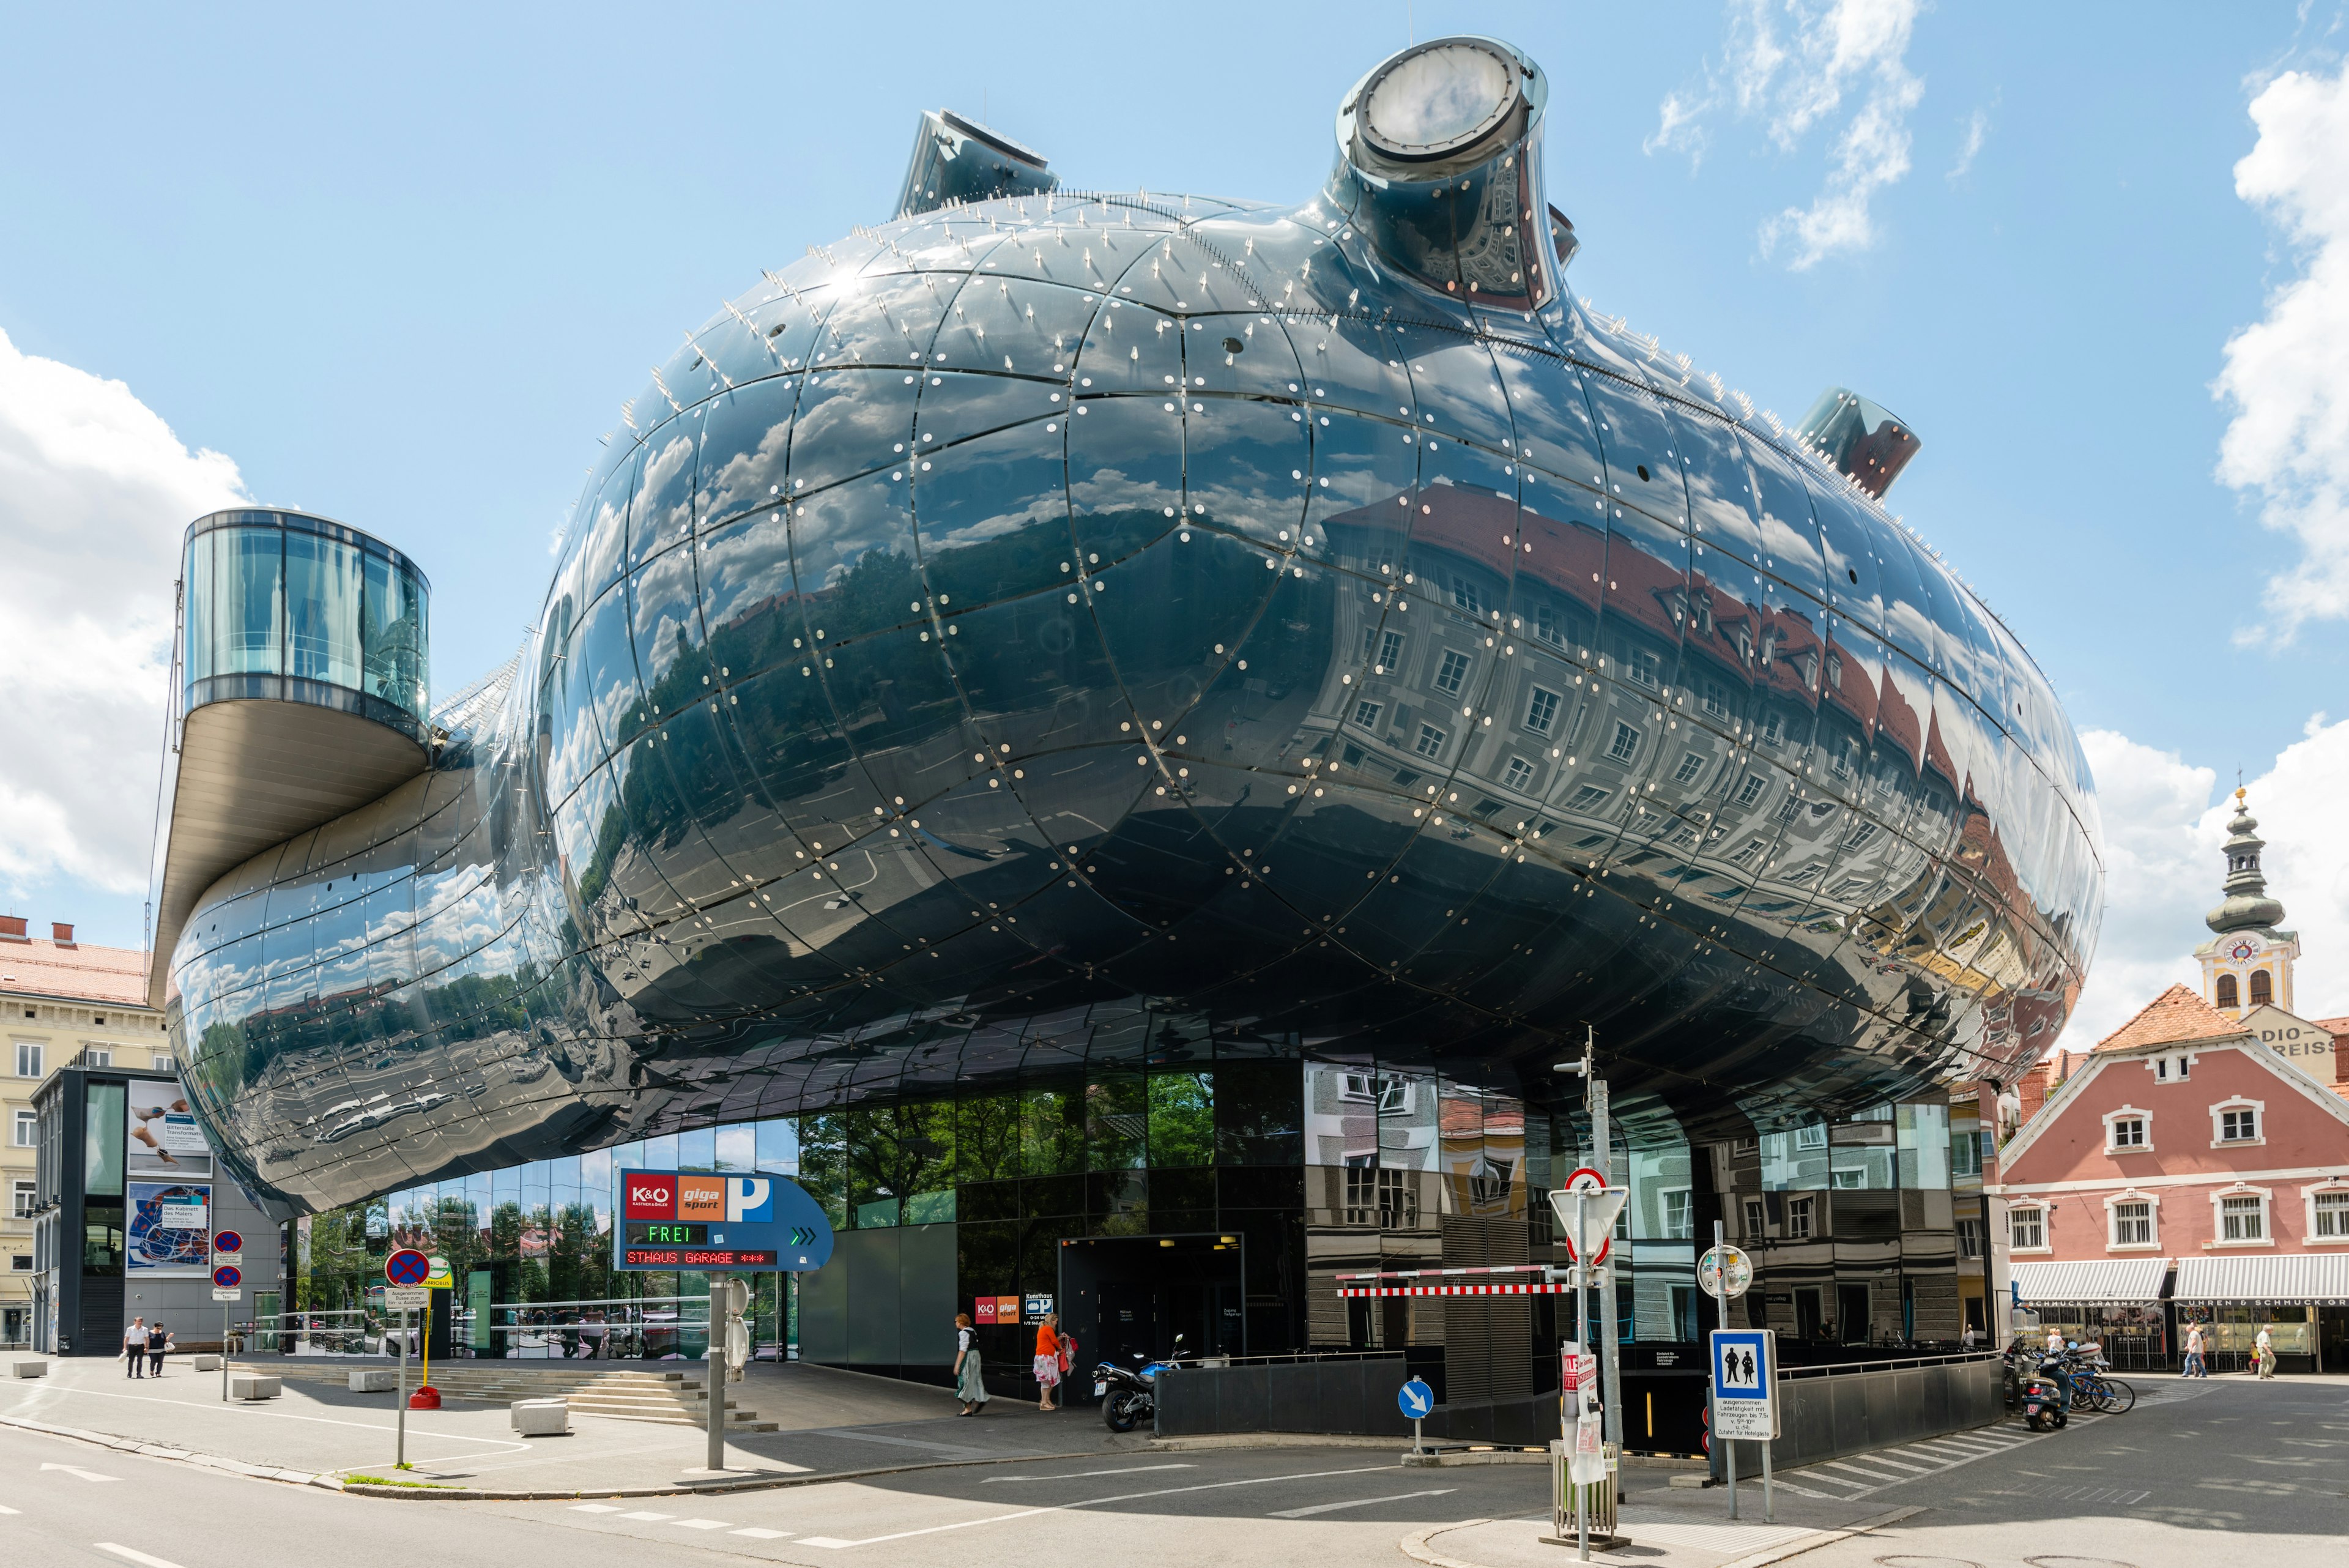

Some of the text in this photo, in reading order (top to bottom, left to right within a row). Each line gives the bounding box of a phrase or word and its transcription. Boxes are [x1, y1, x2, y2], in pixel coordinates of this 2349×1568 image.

[683, 1188, 719, 1202] giga
[728, 1177, 770, 1222] P
[684, 1202, 719, 1210] sport
[648, 1226, 689, 1243] FREI
[628, 1252, 733, 1263] STHAUS GARAGE
[1000, 1303, 1017, 1312] giga
[1564, 1358, 1578, 1373] KLE
[1583, 1358, 1593, 1366] Sonntag
